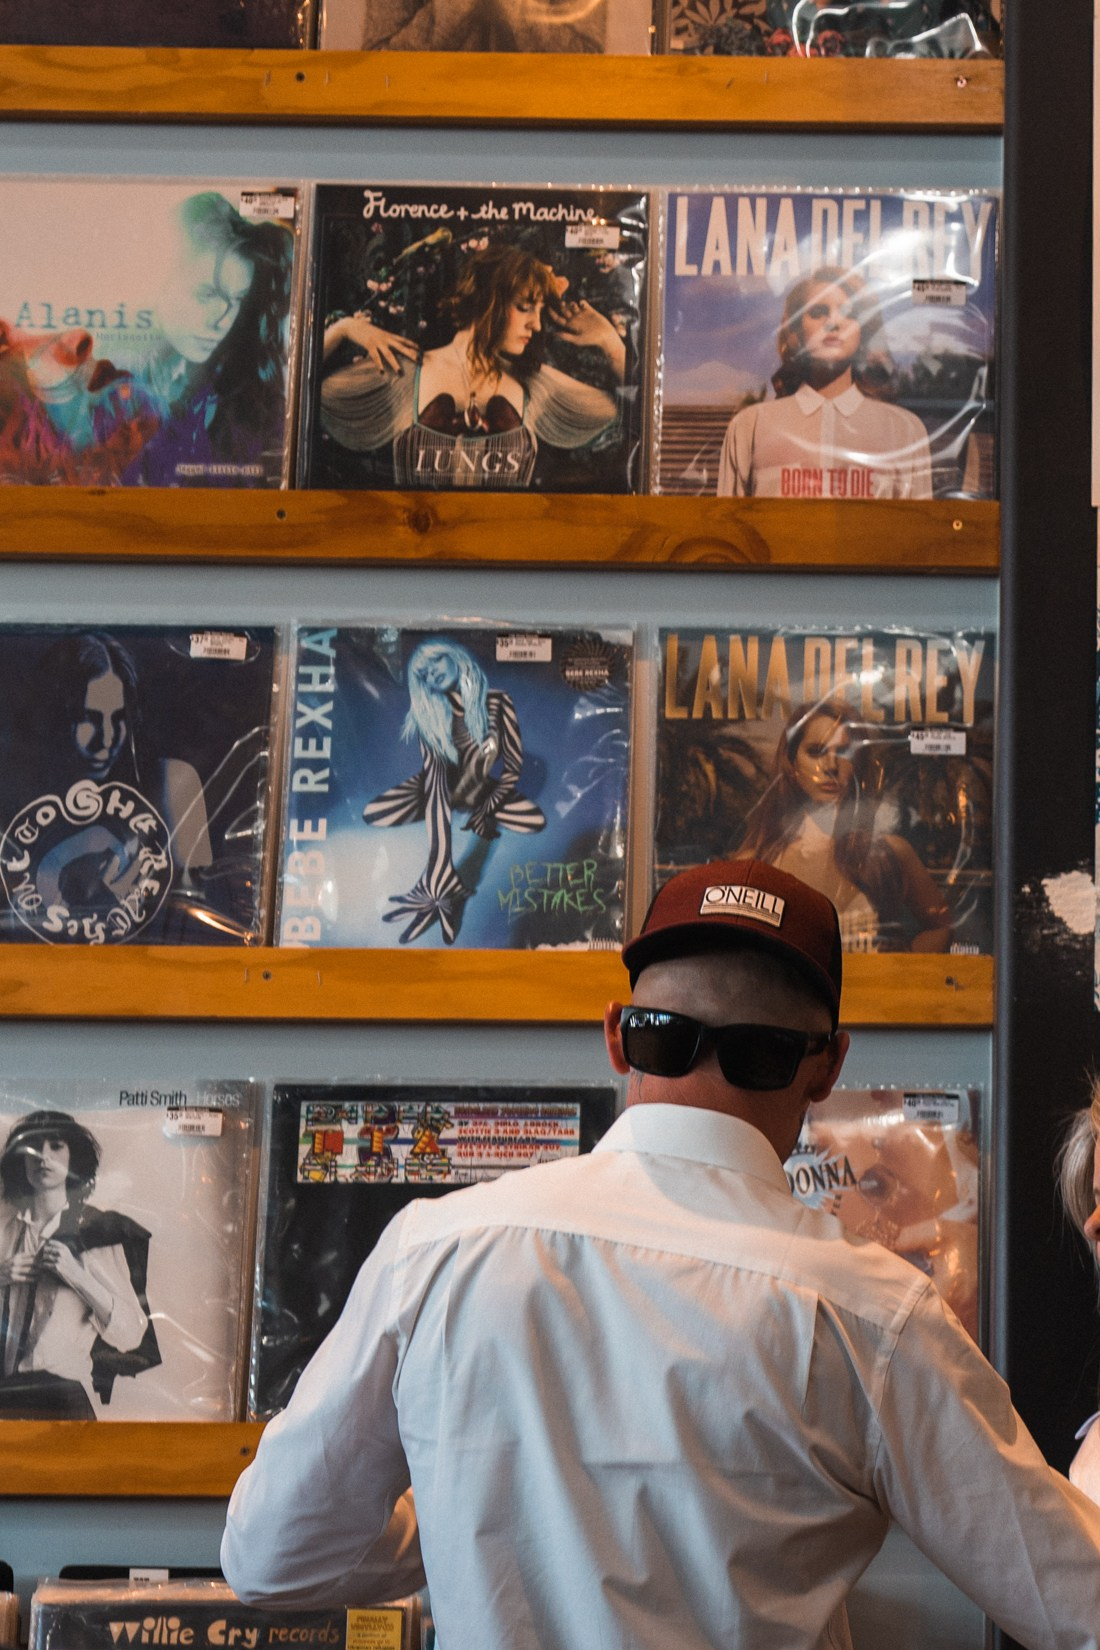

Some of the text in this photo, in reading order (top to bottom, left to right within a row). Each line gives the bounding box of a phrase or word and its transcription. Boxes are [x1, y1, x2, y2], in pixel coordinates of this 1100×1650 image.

[363, 189, 598, 222] Florence + the Machine
[673, 197, 992, 278] LANA DEL REY
[14, 301, 154, 329] Alanis
[415, 448, 520, 475] LUNGS
[780, 468, 875, 497] BORN TO DIE
[665, 634, 985, 727] LANA DEL REY
[281, 628, 337, 948] BEBE REXHA
[510, 859, 597, 890] BETTER
[497, 887, 606, 919] MISTAKES
[705, 886, 781, 915] O'NEILL
[119, 1091, 148, 1106] Patti
[151, 1091, 187, 1106] Smith
[109, 1616, 195, 1645] Willie
[207, 1619, 259, 1648] Cry
[269, 1620, 340, 1646] records
